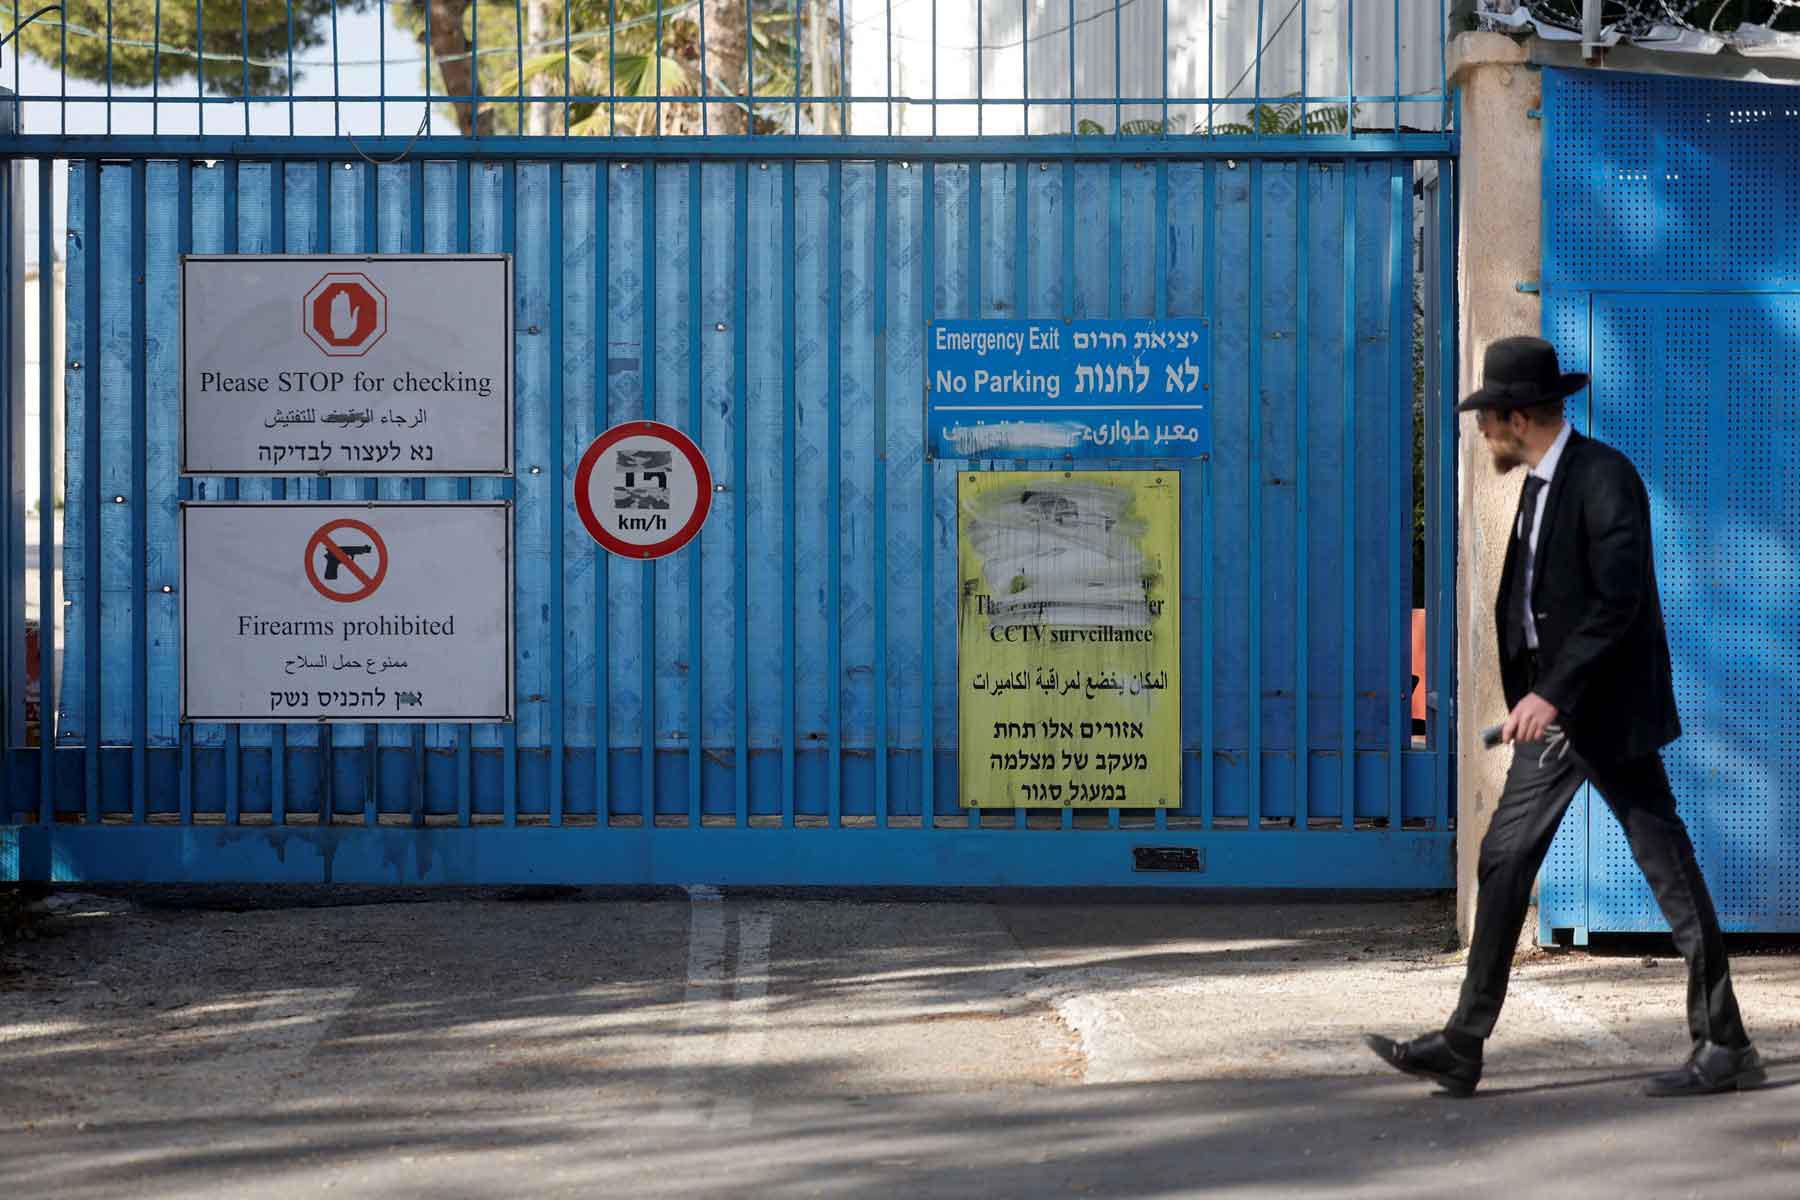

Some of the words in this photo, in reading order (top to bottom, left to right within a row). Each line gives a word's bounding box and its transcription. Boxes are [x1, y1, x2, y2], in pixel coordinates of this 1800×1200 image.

[935, 327, 1024, 356] Emergency
[1029, 327, 1060, 350] Exit
[1072, 331, 1127, 349] חרום
[1133, 331, 1199, 349] יציאת
[200, 372, 269, 393] Please
[278, 371, 344, 393] STOP
[353, 371, 385, 392] for
[393, 371, 492, 397] checking
[936, 370, 967, 393] No
[974, 370, 1061, 399] Parking
[1074, 355, 1150, 393] לחנות
[1165, 355, 1199, 393] לא
[264, 408, 316, 429] للتفتيش
[380, 408, 427, 429] الرجاء
[1153, 423, 1199, 445] معبر
[258, 441, 333, 466] לבדיקה
[341, 441, 402, 461] לעצור
[410, 445, 434, 461] נא
[618, 514, 667, 532] km/h
[238, 615, 335, 637] Firearms
[343, 615, 455, 641] prohibited
[990, 625, 1046, 643] CCTV
[1050, 625, 1153, 643] surveillance
[284, 654, 328, 675] السلاح
[332, 655, 362, 671] حمل
[366, 658, 408, 675] ممنوع
[972, 670, 1031, 696] الكاميرات
[1035, 666, 1081, 696] لمراقبة
[1085, 671, 1124, 699] يخضع
[1129, 670, 1168, 696] المكان
[270, 690, 309, 711] נשק
[317, 687, 386, 707] להכניס
[993, 722, 1036, 739] תחת
[1042, 717, 1074, 739] אלו
[1080, 722, 1144, 739] אזורים
[990, 749, 1056, 771] מצלמה
[1061, 749, 1089, 770] של
[1095, 754, 1148, 775] מעקב
[1021, 783, 1063, 801] סגור
[1069, 780, 1127, 801] במעגל
